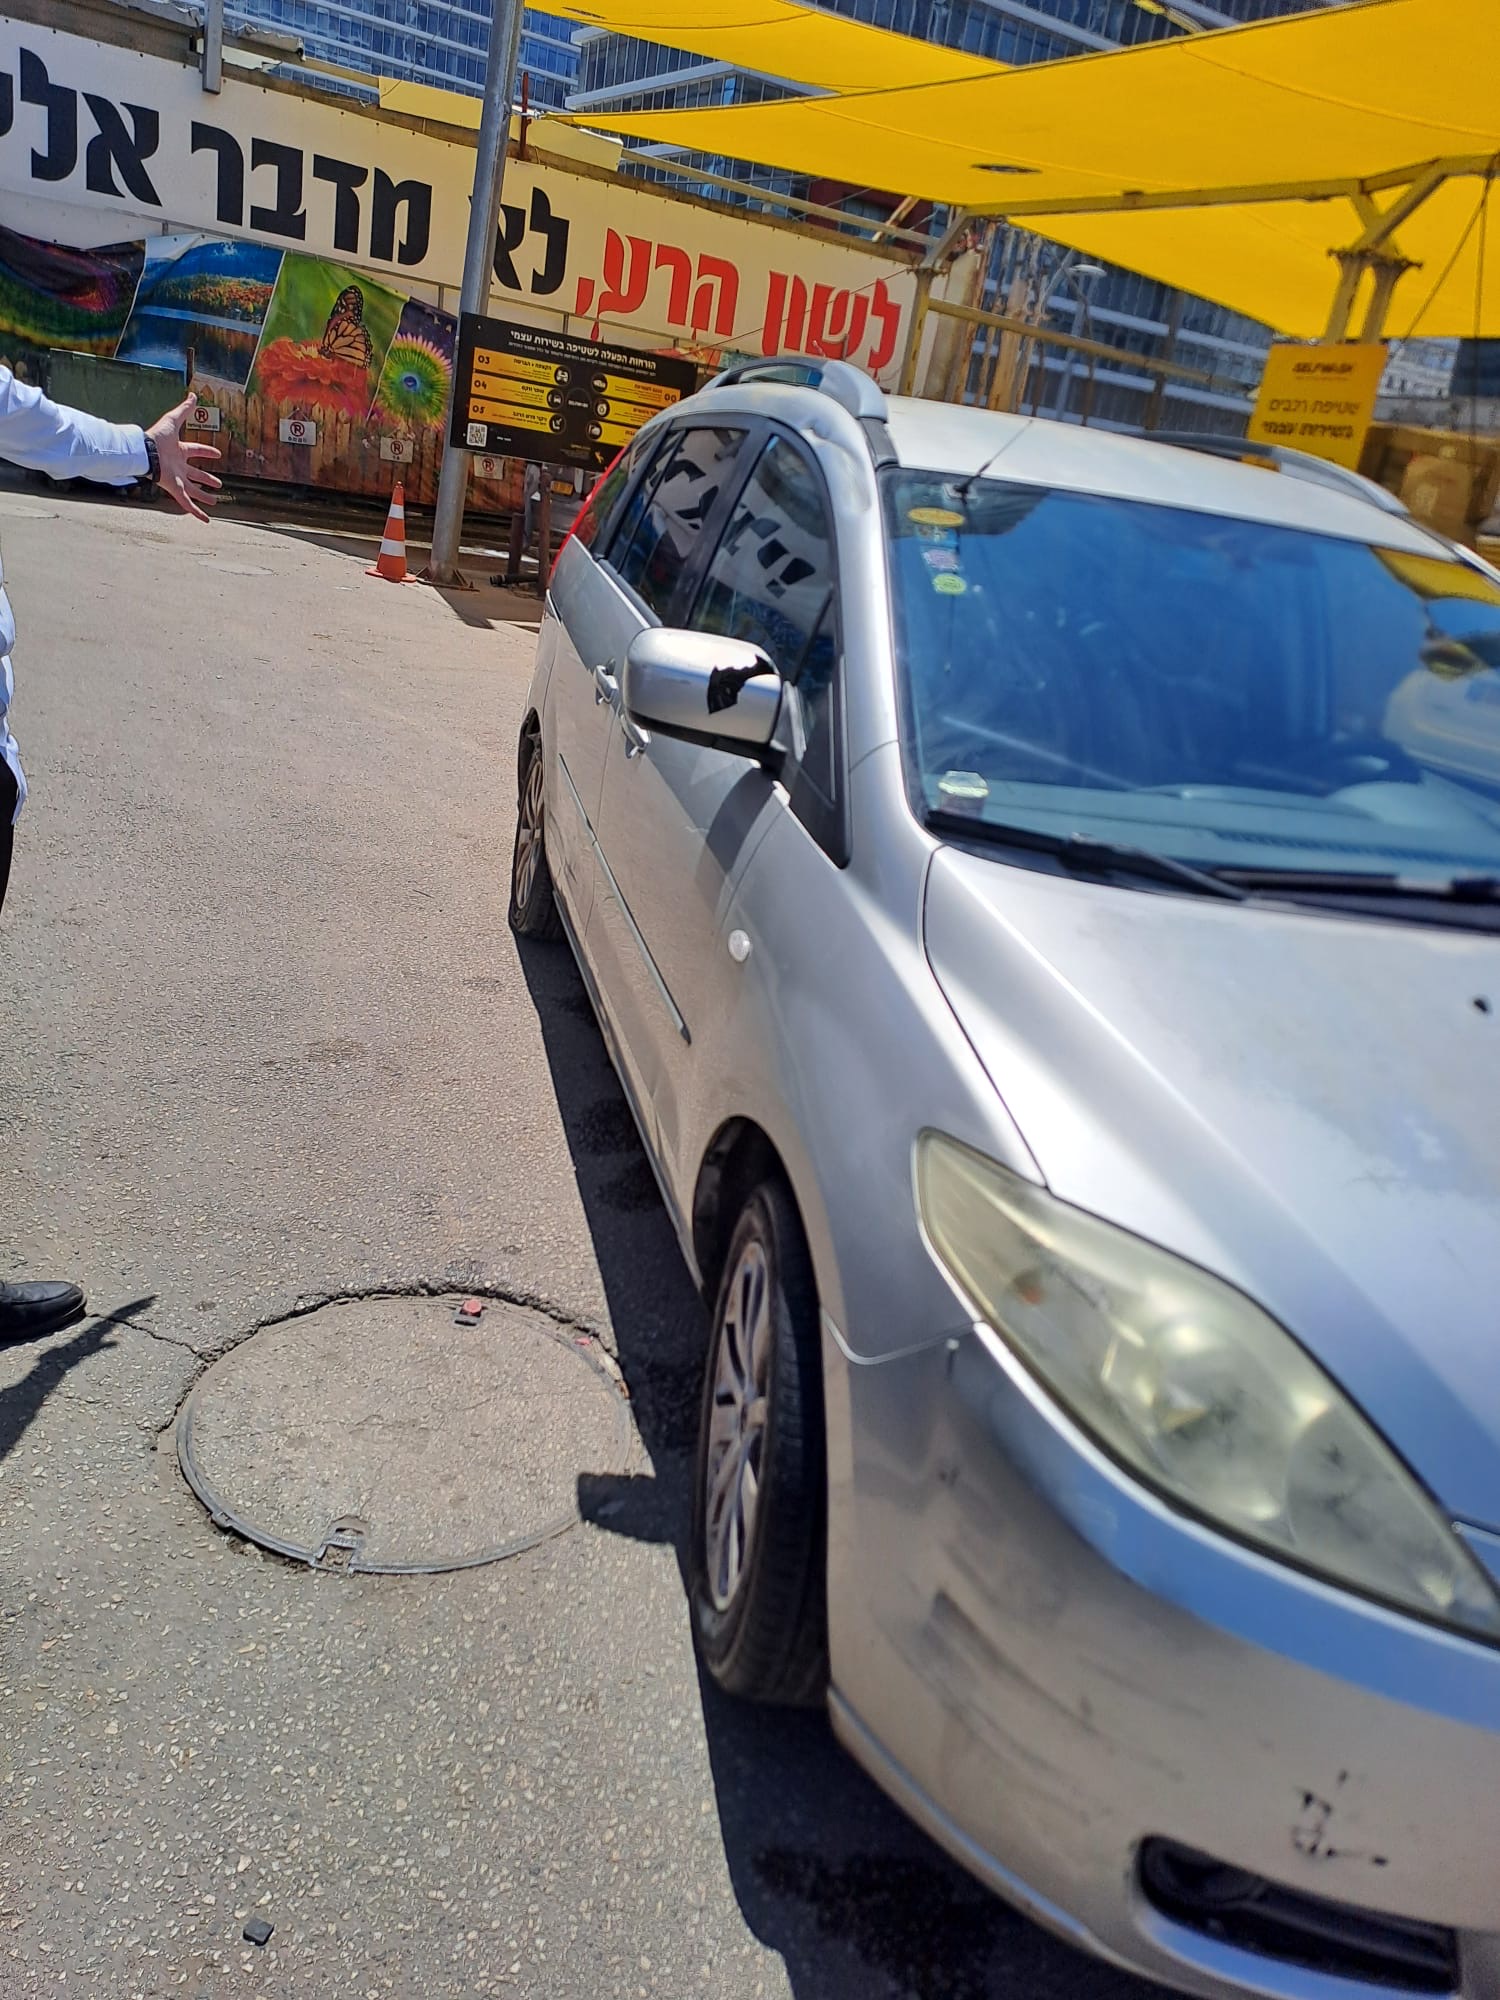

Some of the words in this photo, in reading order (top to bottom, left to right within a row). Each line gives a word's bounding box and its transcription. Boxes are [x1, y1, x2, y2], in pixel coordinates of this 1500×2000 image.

[191, 120, 433, 266] מדבר
[468, 186, 570, 296] לא
[575, 227, 740, 337] הרע,
[762, 270, 902, 369] לשון
[510, 330, 533, 342] עצמי
[534, 335, 565, 350] בשירות
[566, 342, 600, 357] לשטיפה
[601, 349, 628, 364] הפעלה
[478, 355, 490, 364] 03
[474, 380, 487, 390] 04
[472, 405, 486, 414] 05
[1269, 399, 1308, 412] רכבים
